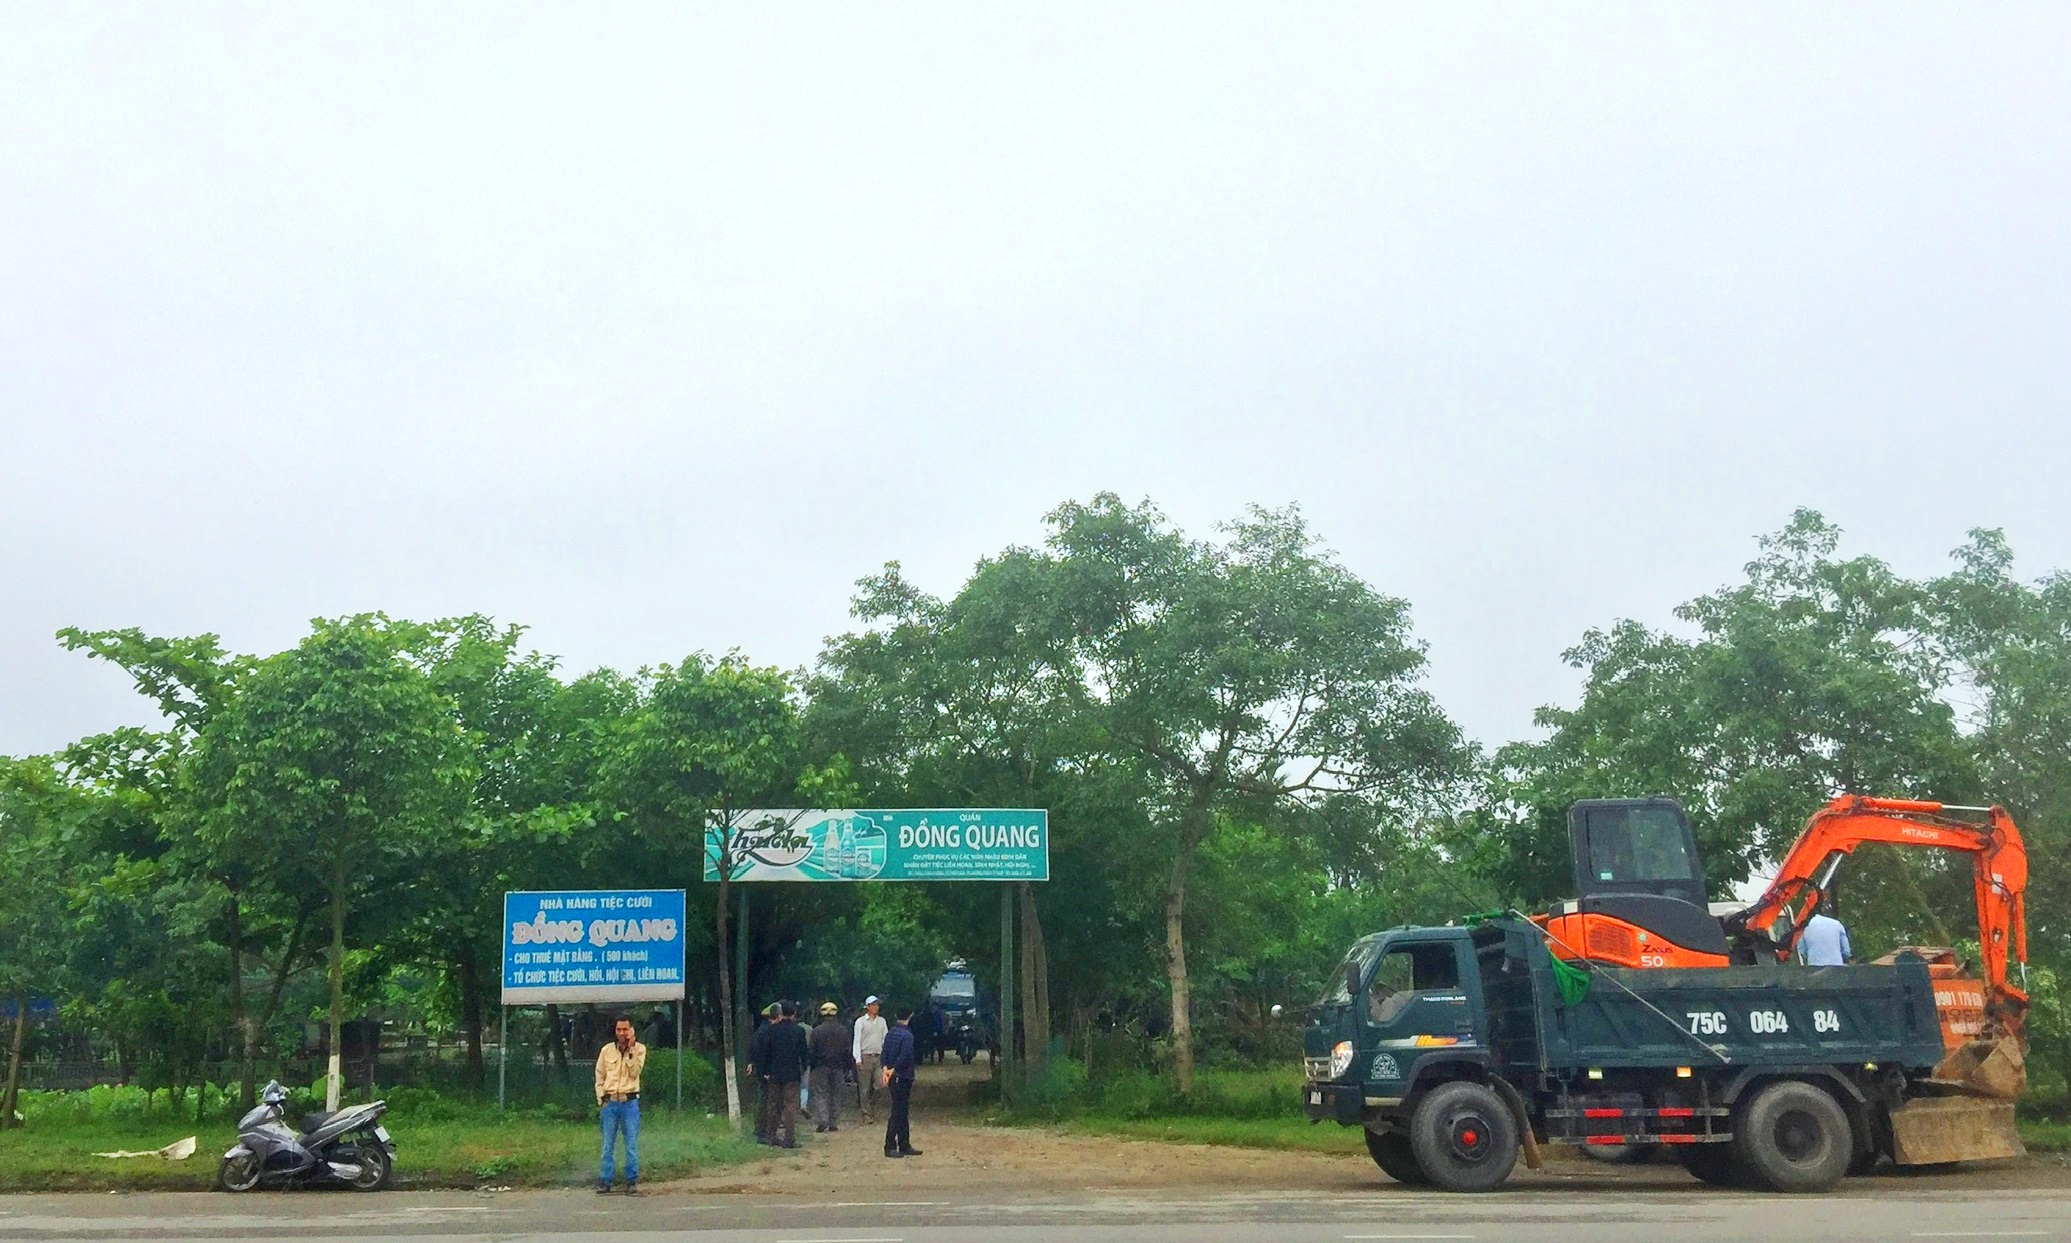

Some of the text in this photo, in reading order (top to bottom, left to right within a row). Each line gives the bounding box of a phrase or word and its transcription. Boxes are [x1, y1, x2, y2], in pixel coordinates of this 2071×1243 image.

[959, 813, 981, 822] QUÁN
[898, 817, 1040, 850] ĐỒNG QUANG
[1902, 827, 1939, 840] HITACHI
[540, 895, 653, 911] NHÀ HÀNG TIỆC CƯỚI
[512, 911, 678, 947] ĐỒNG QUANG
[514, 952, 531, 964] CHO
[1641, 955, 1664, 967] 50
[548, 967, 565, 985] TIỆC
[1686, 1010, 1840, 1034] 75C 064 84
